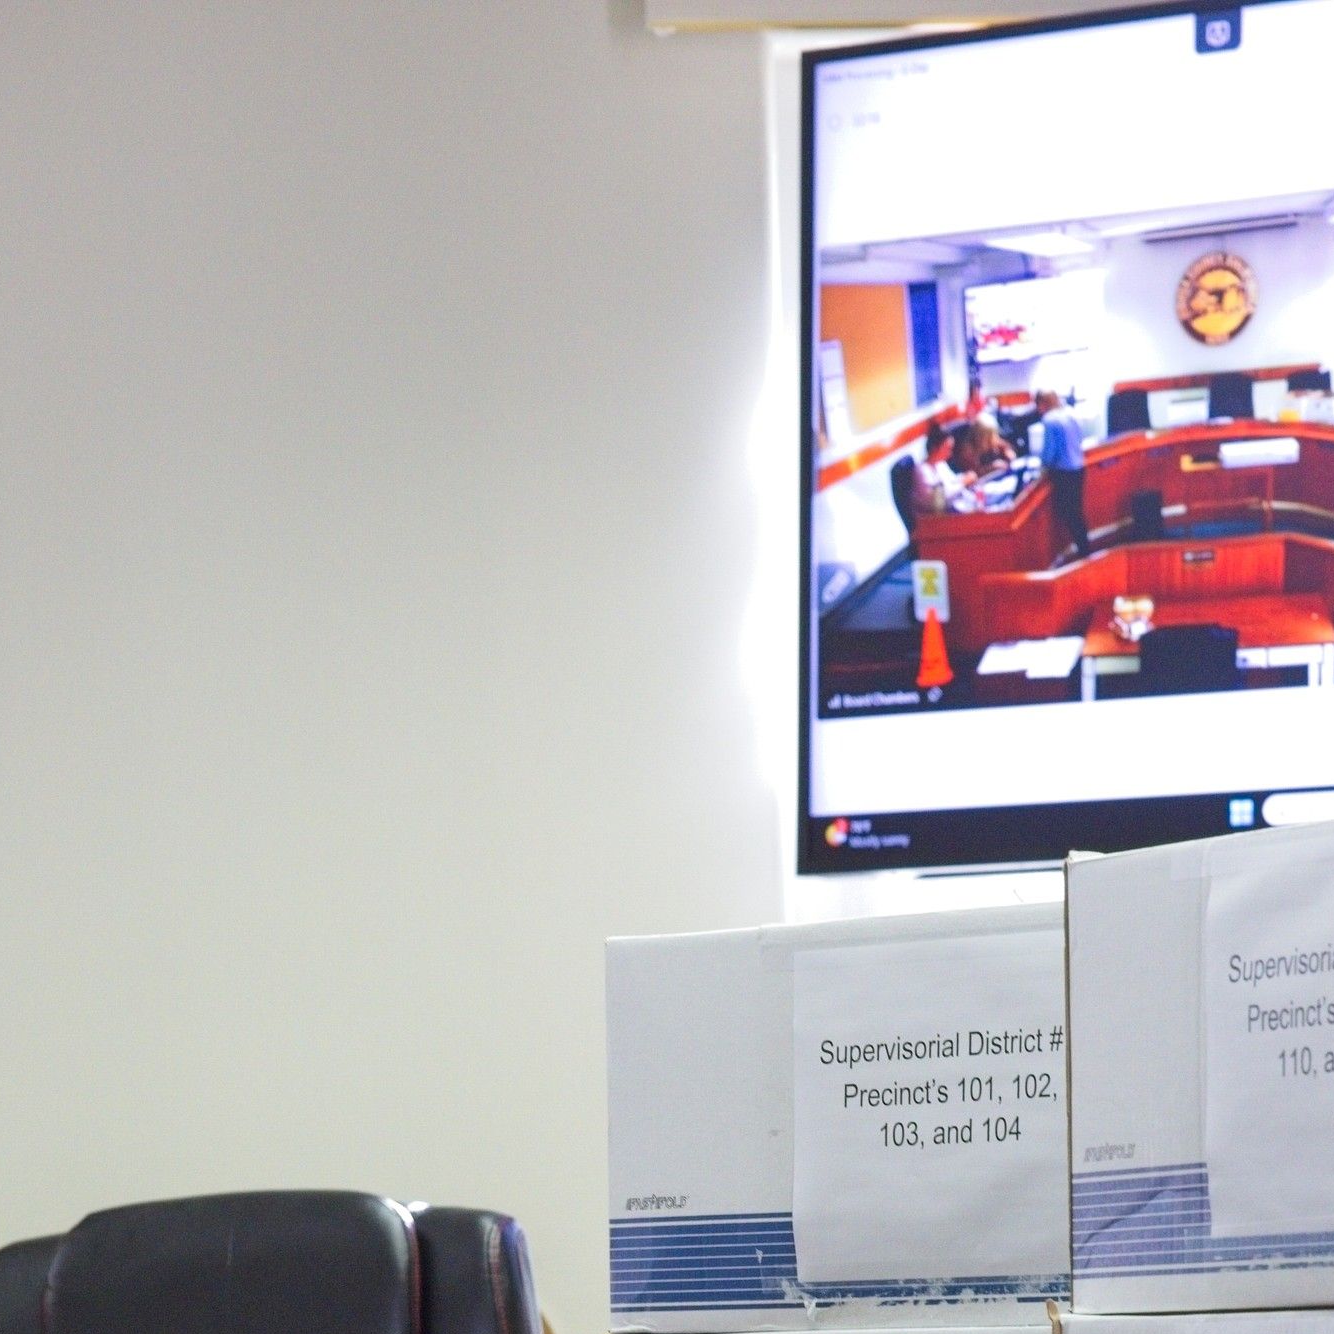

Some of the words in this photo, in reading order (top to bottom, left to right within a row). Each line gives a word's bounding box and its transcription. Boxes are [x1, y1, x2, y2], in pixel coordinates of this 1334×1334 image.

[819, 1032, 960, 1070] Supervisorial
[968, 1028, 1043, 1056] District
[1049, 1025, 1064, 1052] #
[1278, 1045, 1318, 1078] 110,
[844, 1078, 949, 1108] Precinct's
[957, 1076, 1002, 1105] 101,
[1012, 1072, 1057, 1102] 102,
[880, 1121, 925, 1150] 103,
[933, 1118, 973, 1145] and
[982, 1115, 1022, 1143] 104
